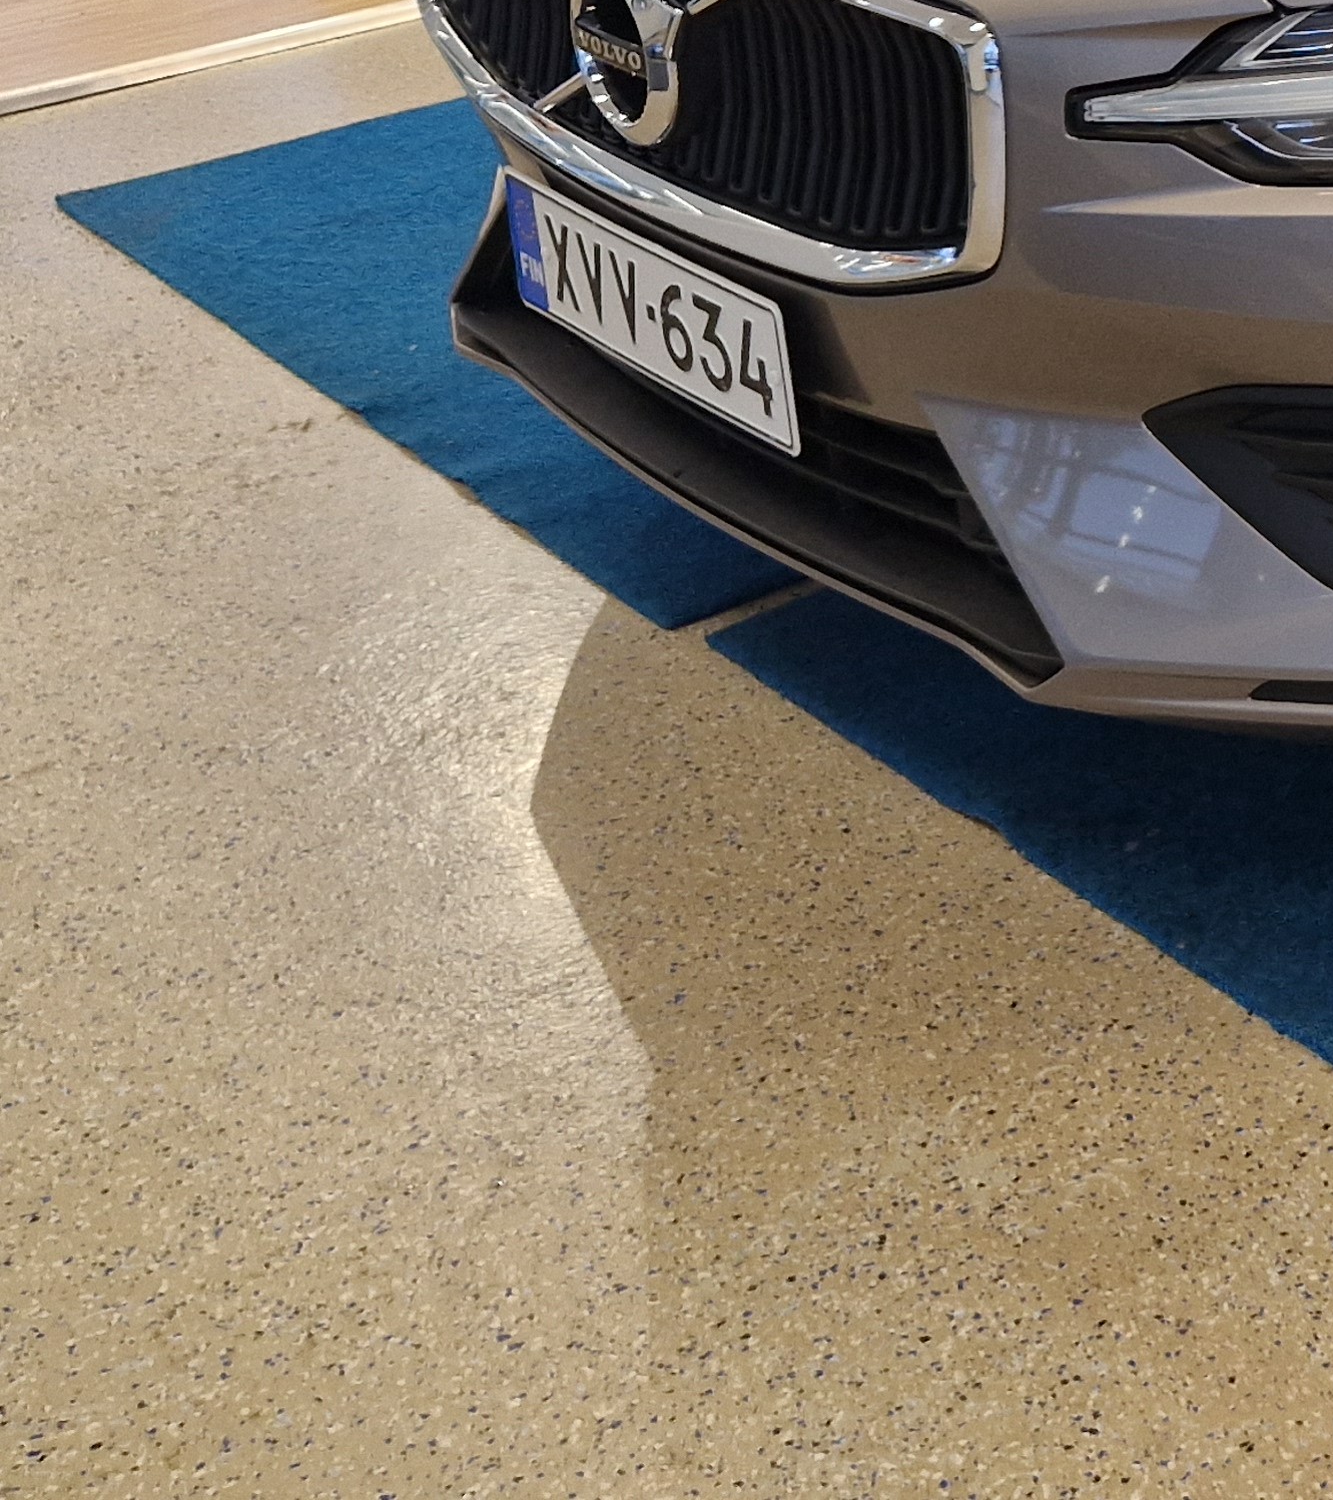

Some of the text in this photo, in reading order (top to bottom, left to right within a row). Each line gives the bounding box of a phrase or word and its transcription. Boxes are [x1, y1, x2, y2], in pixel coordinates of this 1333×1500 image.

[578, 29, 642, 70] VOLVO
[519, 214, 773, 419] FIN XVV-634
